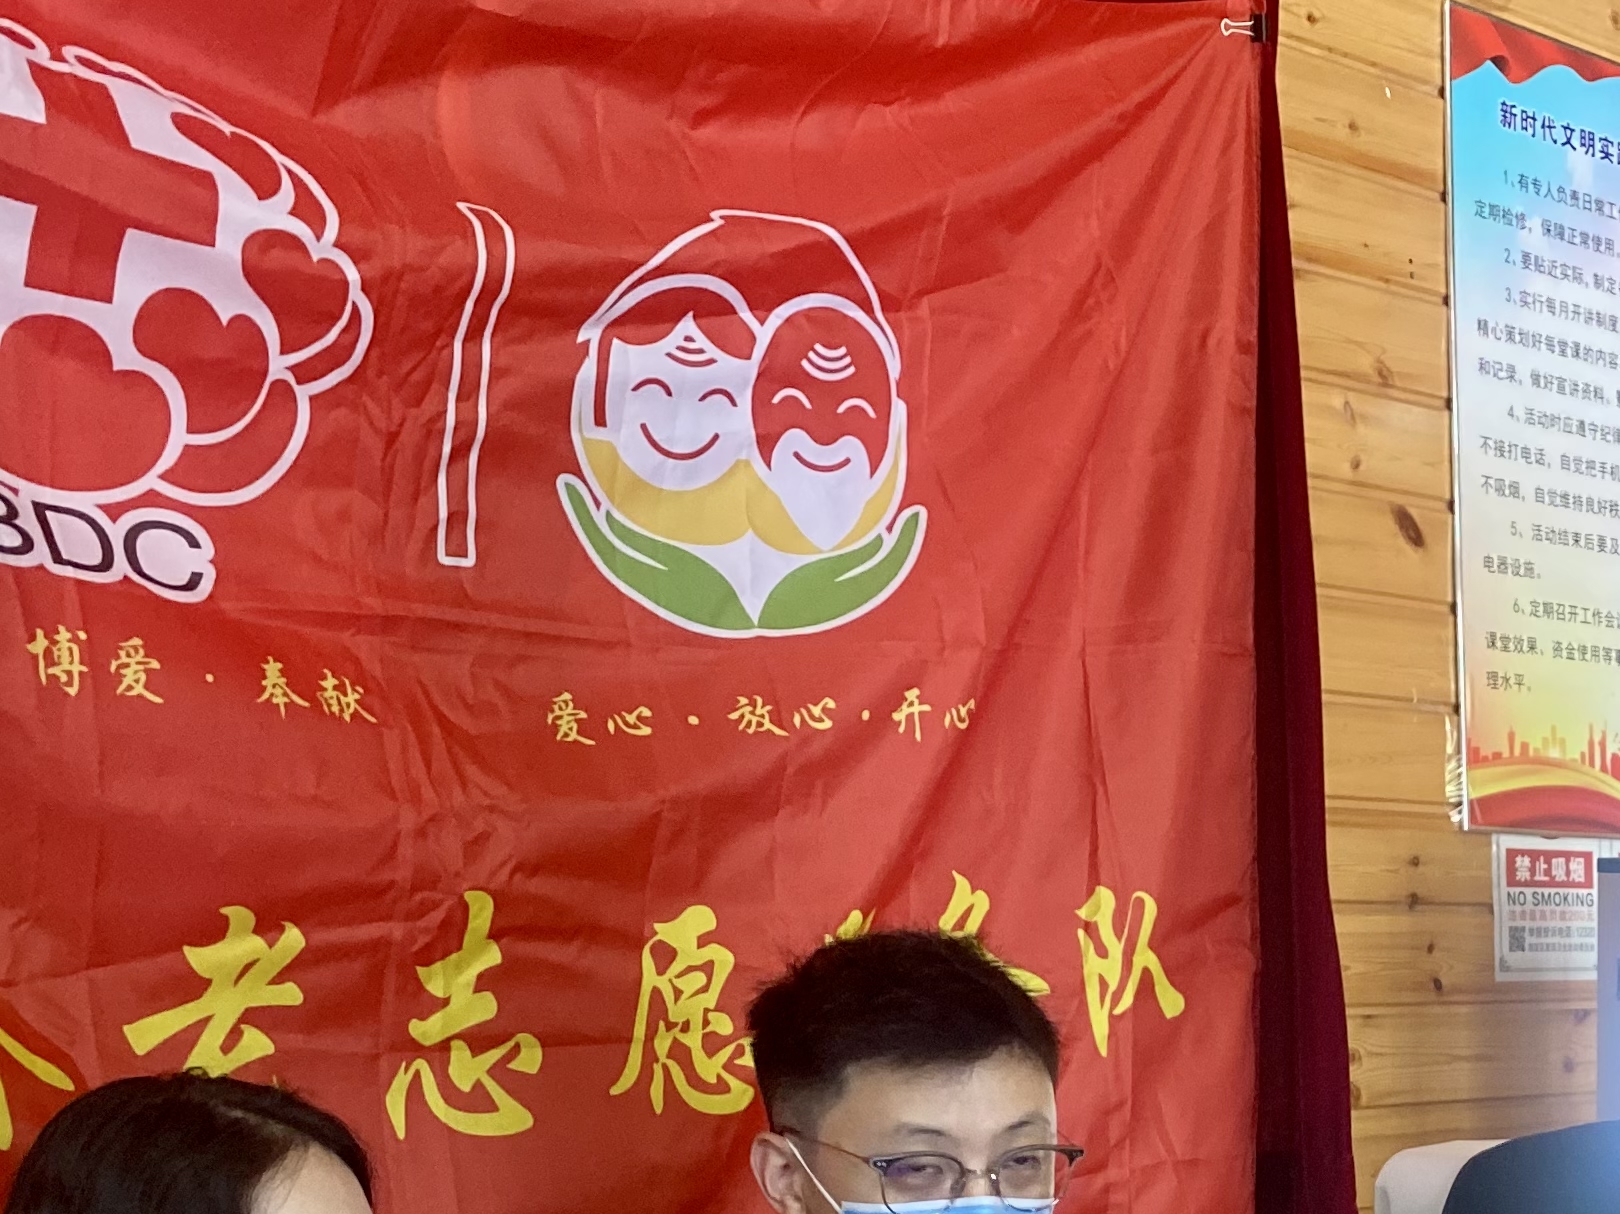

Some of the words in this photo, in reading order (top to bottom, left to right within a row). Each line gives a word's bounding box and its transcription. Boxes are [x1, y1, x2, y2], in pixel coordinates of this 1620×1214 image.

[1514, 854, 1585, 882] 禁止吸烟
[1507, 891, 1526, 906] NO
[1532, 891, 1594, 907] SMOKING
